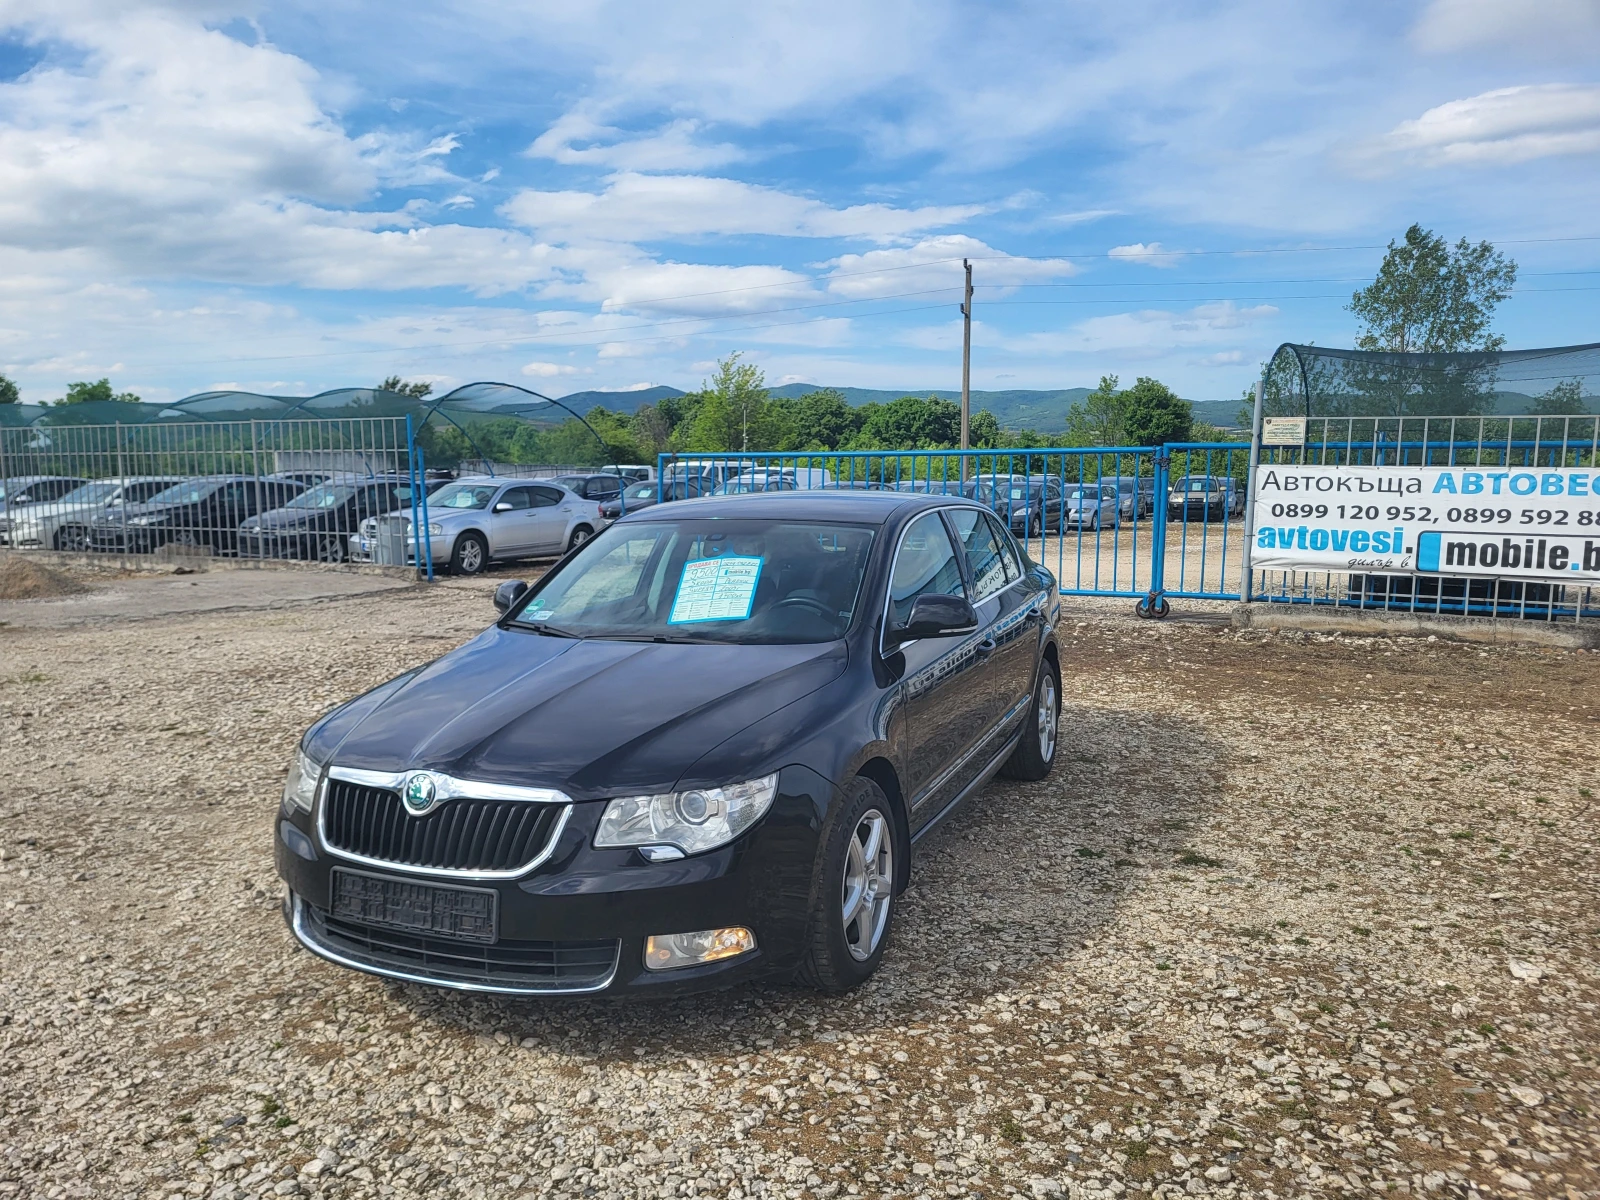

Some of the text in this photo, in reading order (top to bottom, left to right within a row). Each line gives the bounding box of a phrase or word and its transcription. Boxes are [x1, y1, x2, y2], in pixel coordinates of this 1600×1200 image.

[1261, 470, 1422, 498] Автокъща
[1271, 503, 1329, 519] 0899
[1336, 505, 1380, 520] 120
[1386, 506, 1440, 524] 952,
[1446, 507, 1512, 524] 0899
[1519, 509, 1569, 525] 592
[1257, 525, 1414, 555] avtovesi.
